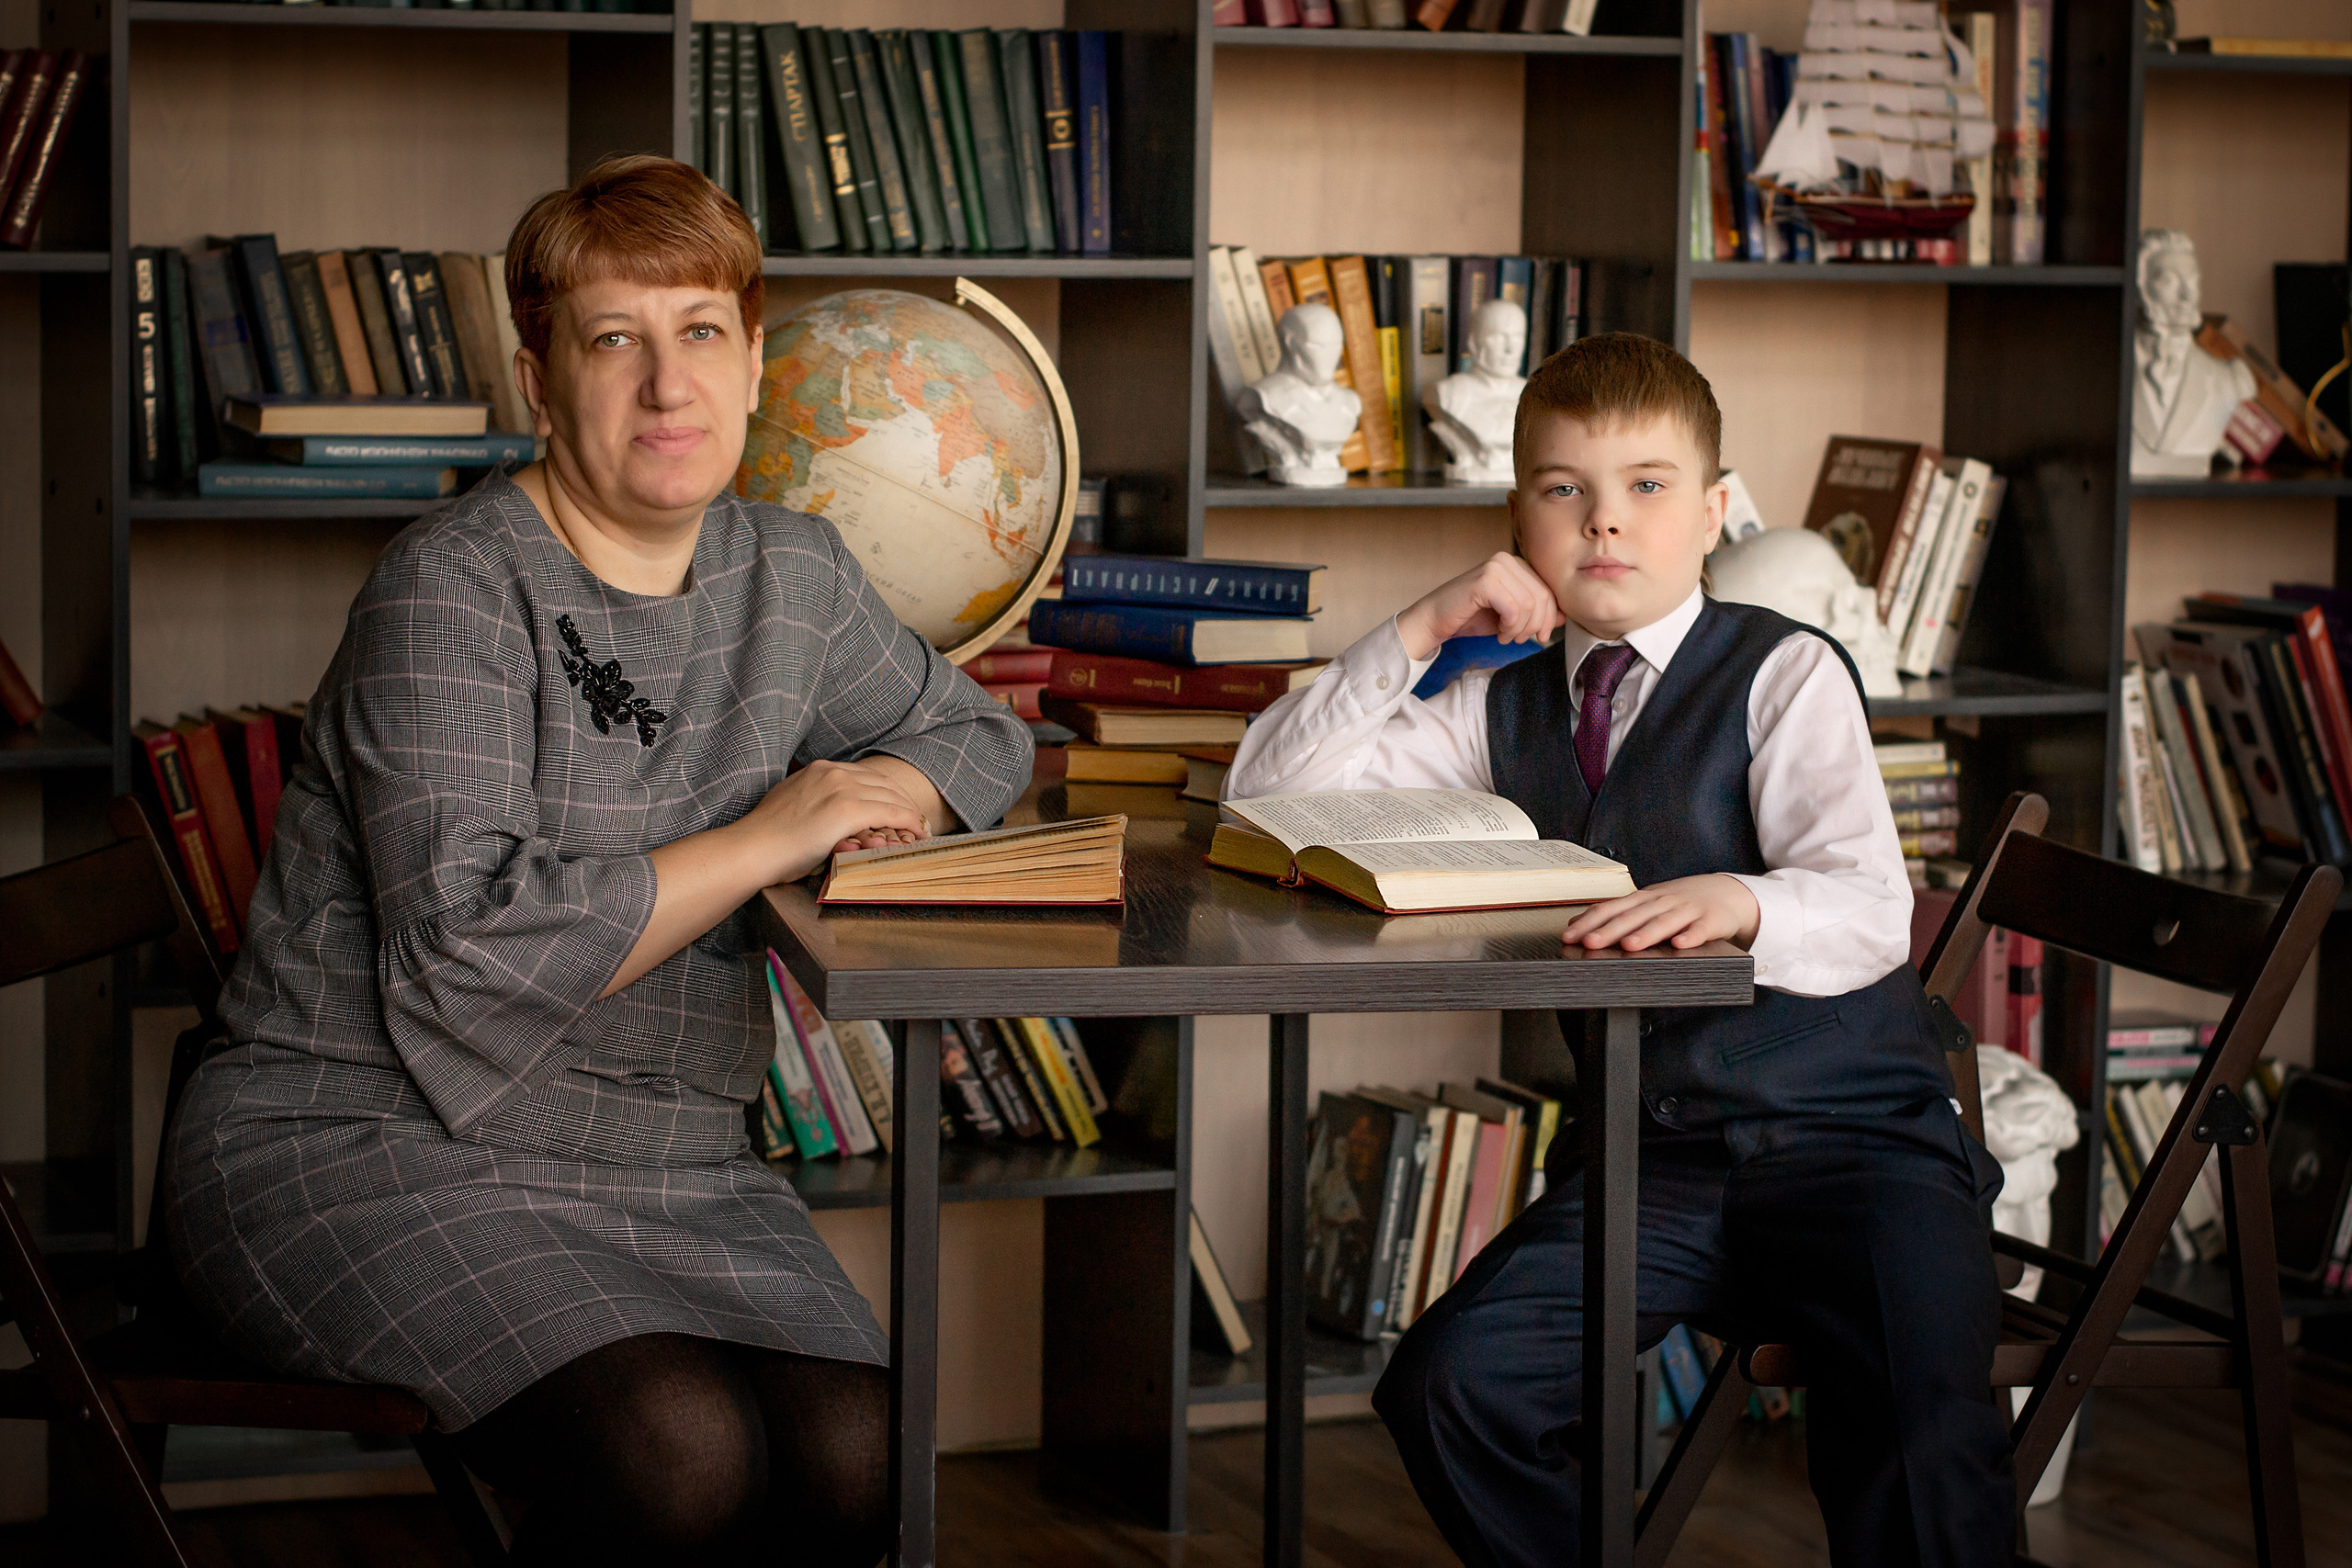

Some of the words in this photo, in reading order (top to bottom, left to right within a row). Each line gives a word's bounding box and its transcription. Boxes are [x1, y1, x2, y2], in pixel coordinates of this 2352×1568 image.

[779, 51, 808, 141] СПАРТАК
[137, 312, 156, 340] 5
[895, 588, 922, 603] ОКЕАН
[1227, 579, 1299, 603] БОРИС
